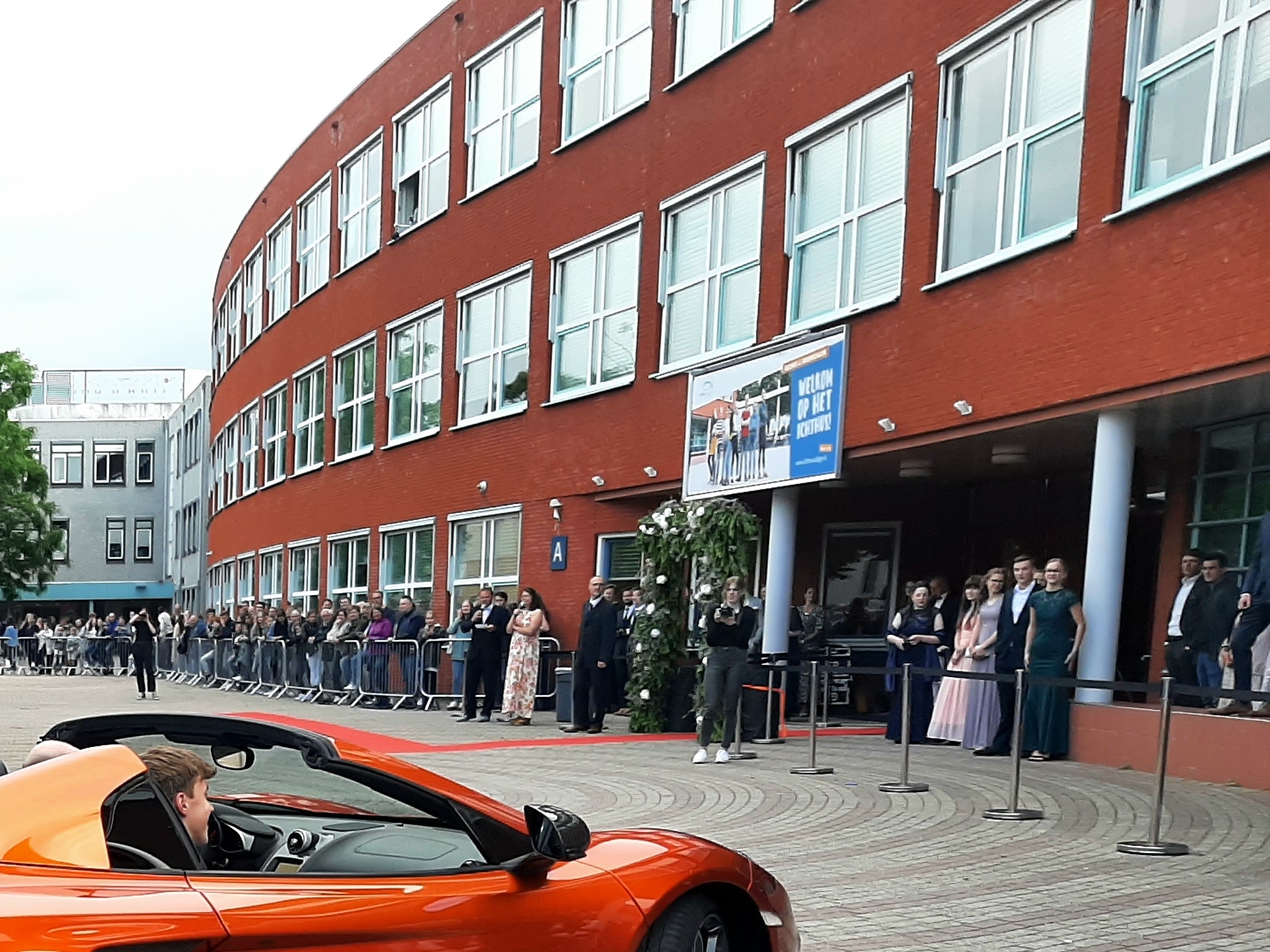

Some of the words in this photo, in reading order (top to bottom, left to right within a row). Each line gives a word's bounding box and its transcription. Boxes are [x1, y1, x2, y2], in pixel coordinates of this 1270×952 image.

[799, 368, 833, 397] WELKOM
[797, 397, 810, 421] OP
[812, 388, 833, 416] HET
[796, 412, 832, 440] ICHTHUS!
[552, 541, 563, 563] A
